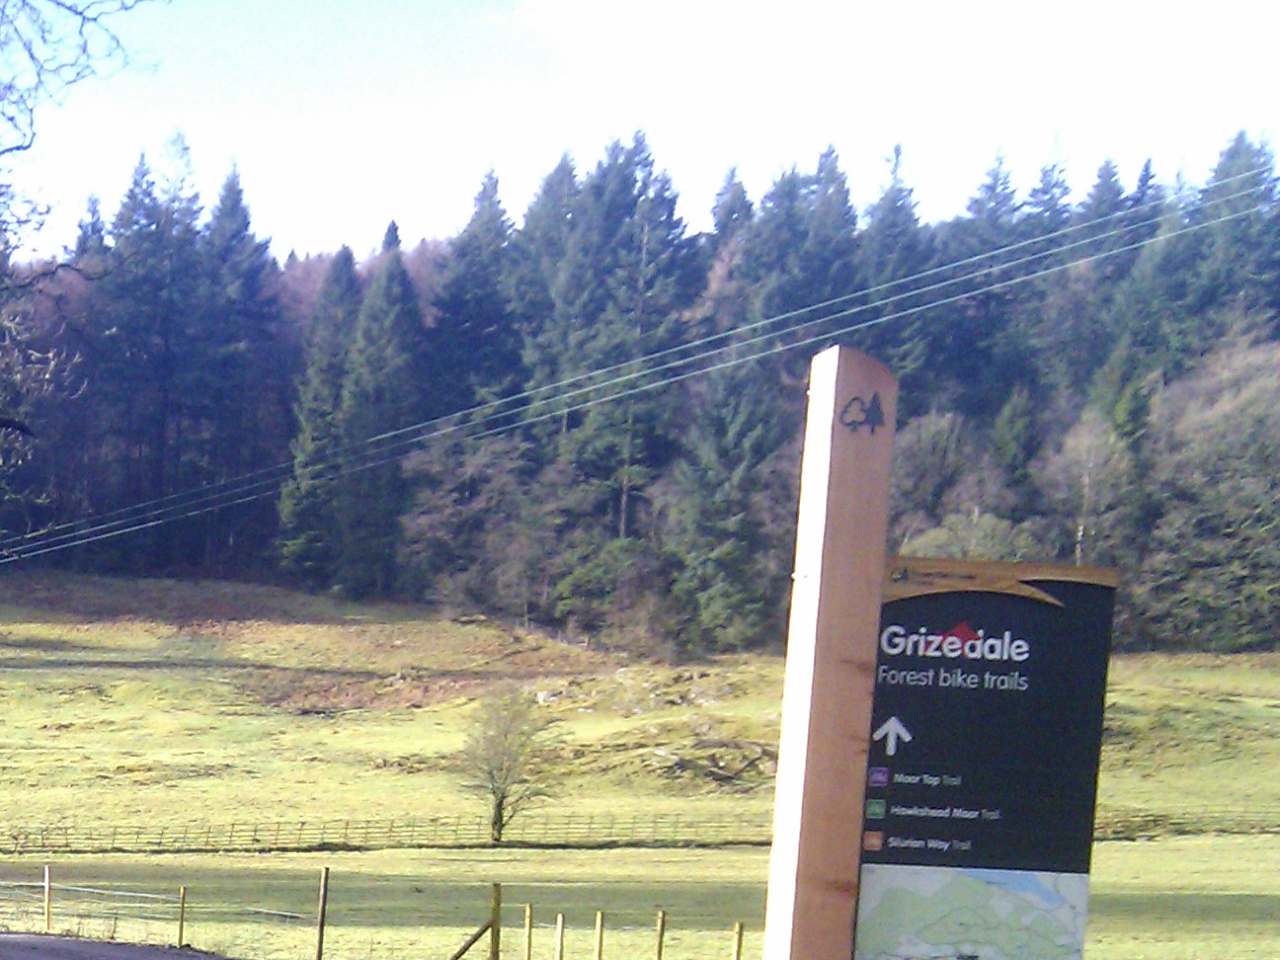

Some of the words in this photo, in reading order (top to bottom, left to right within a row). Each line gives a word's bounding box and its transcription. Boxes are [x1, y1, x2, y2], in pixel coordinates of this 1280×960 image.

[879, 624, 1030, 662] Grizedale
[877, 664, 934, 687] Forest
[940, 665, 979, 688] bike
[984, 668, 1029, 690] trails
